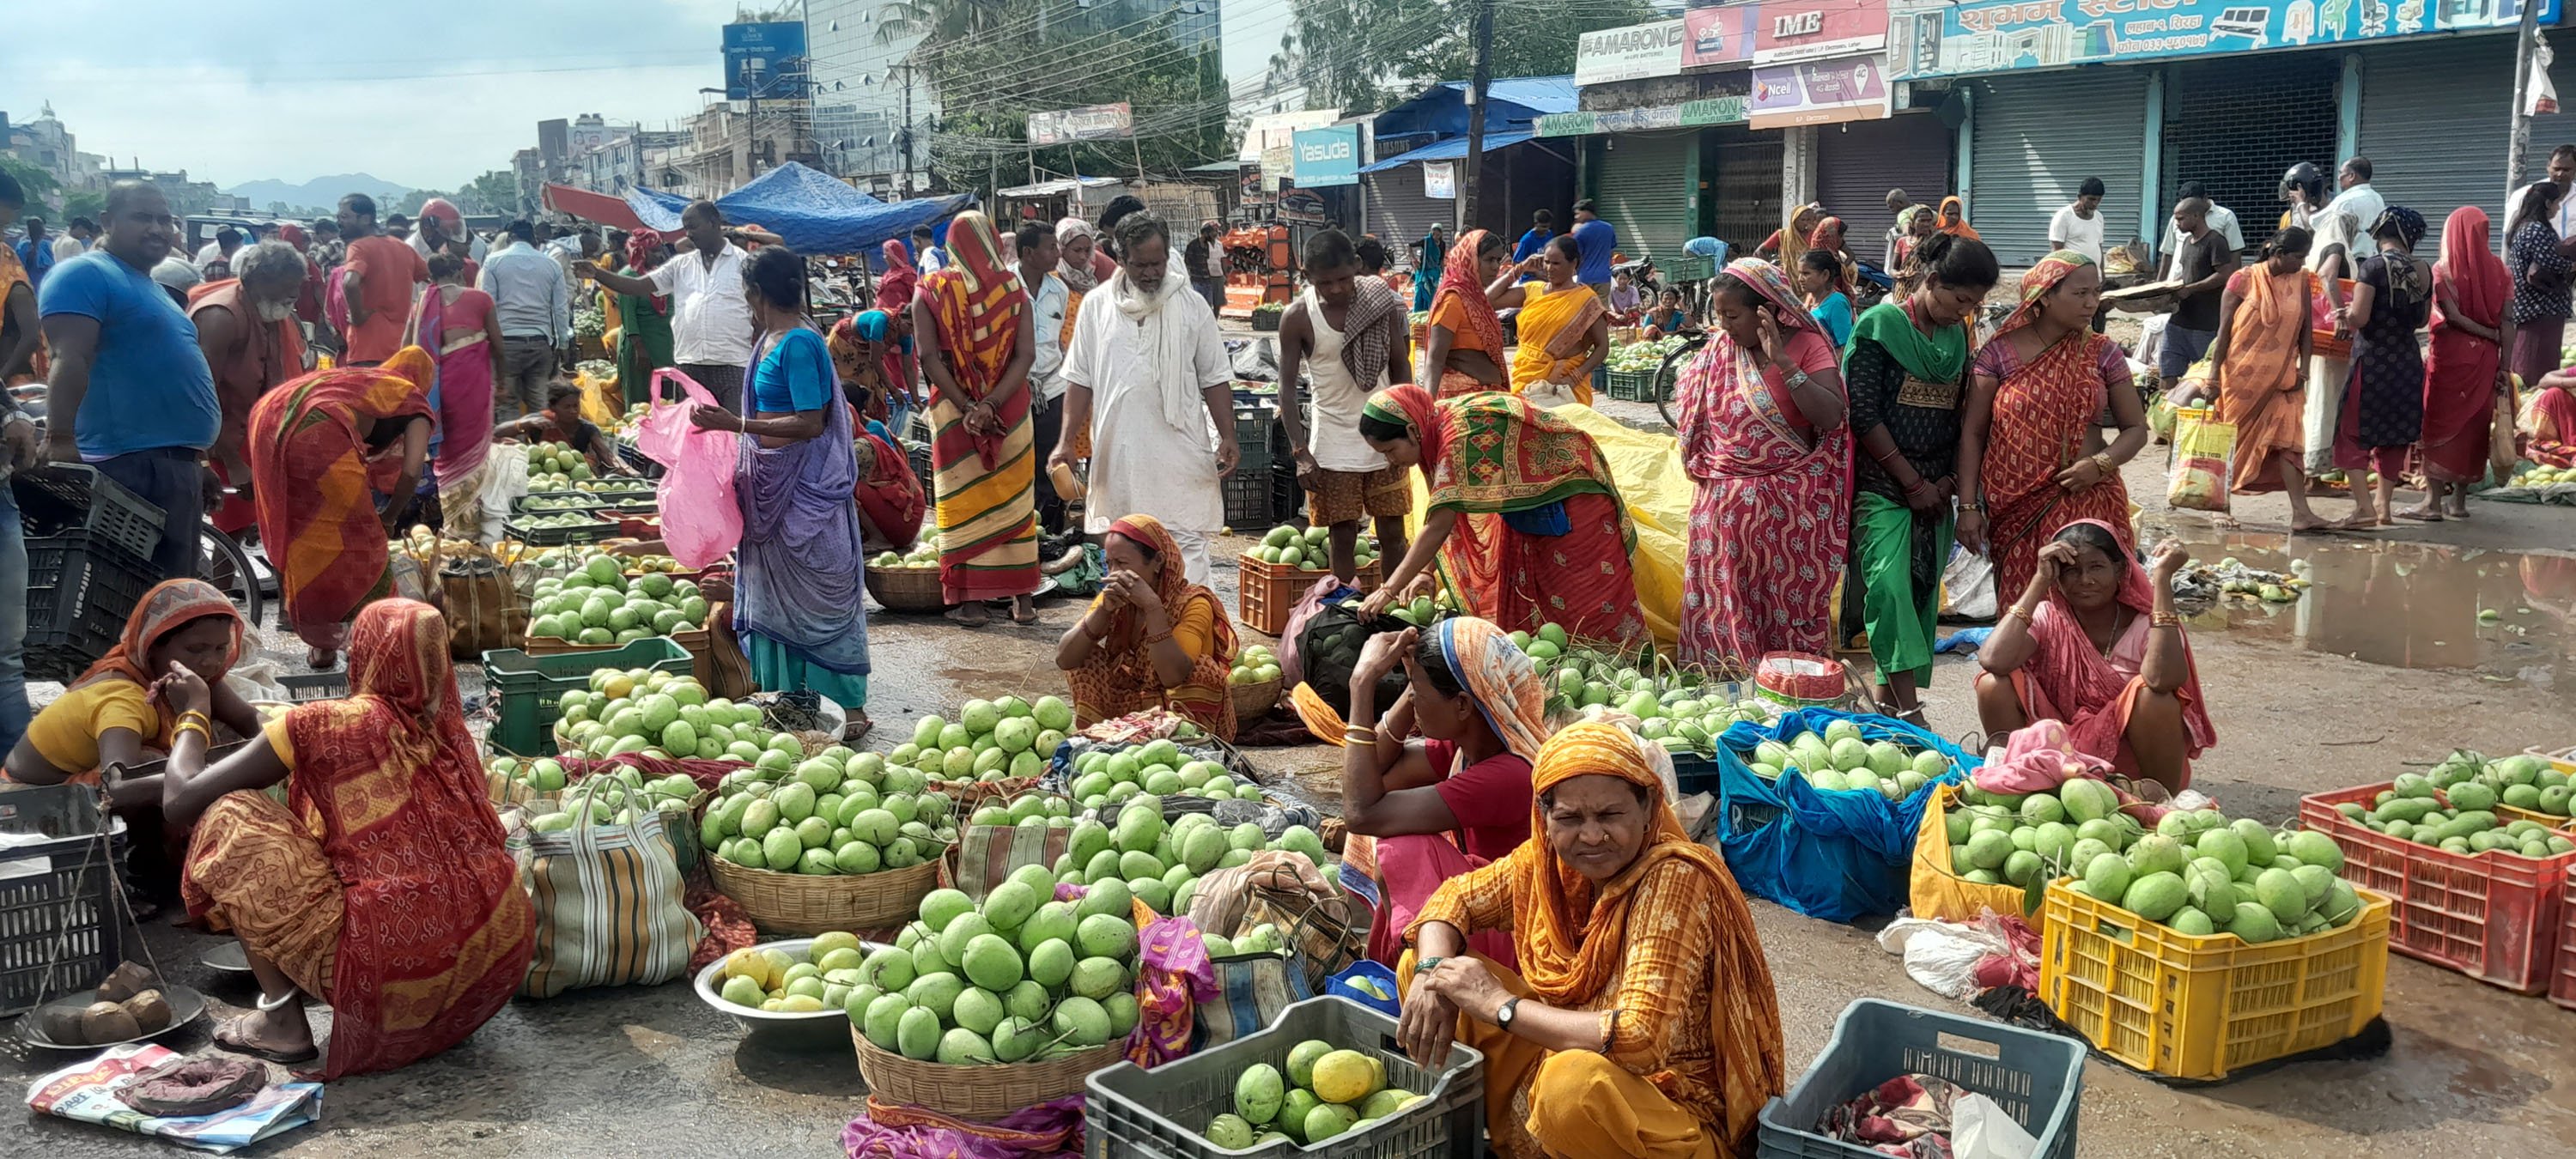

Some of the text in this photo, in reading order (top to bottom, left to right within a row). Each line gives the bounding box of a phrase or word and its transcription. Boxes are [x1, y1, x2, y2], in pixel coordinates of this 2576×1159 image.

[1773, 10, 1822, 38] IME
[1959, 3, 2065, 31] शुभम्
[1592, 27, 1667, 58] AMARON
[1768, 82, 1792, 96] Ncell
[1682, 100, 1739, 118] AMARON
[1544, 115, 1594, 131] AMARON
[1299, 138, 1350, 162] Yasuda
